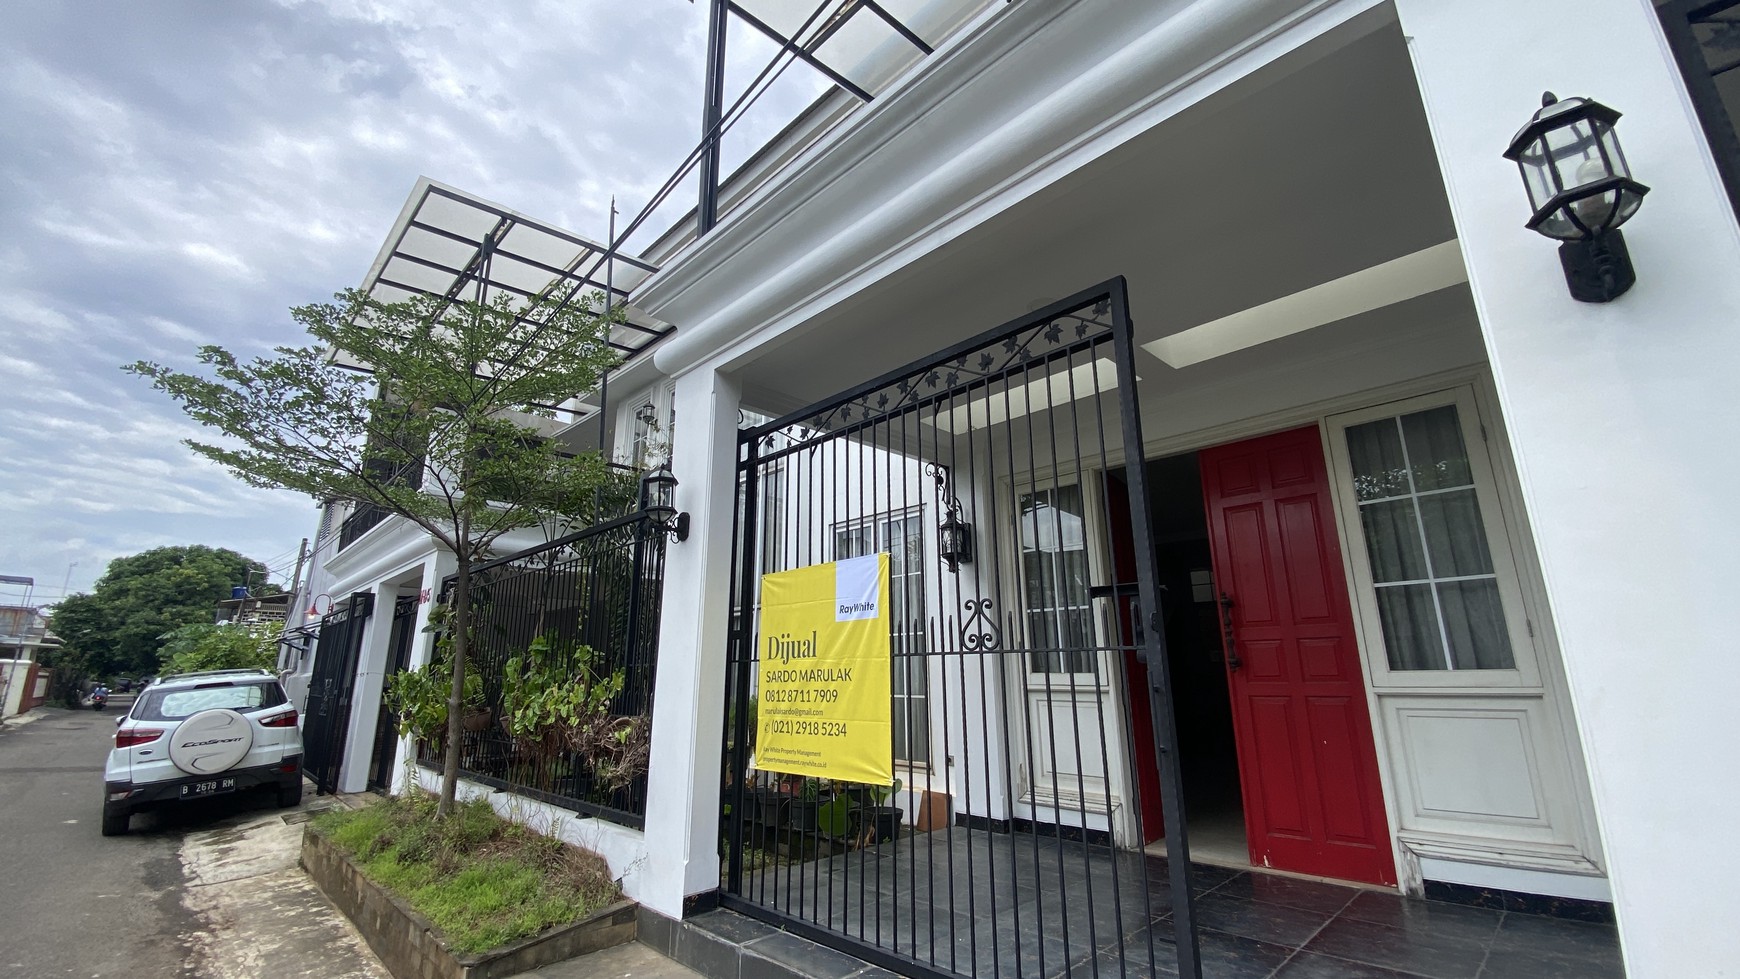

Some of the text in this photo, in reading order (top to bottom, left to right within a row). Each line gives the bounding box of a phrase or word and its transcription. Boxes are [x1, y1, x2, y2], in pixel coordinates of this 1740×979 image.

[839, 602, 875, 615] RayWhite
[767, 630, 817, 665] Dijual
[766, 667, 852, 684] SARDO MARULAK
[765, 689, 838, 703] 0812 8711 7909
[771, 719, 847, 737] (021) 2918 5234
[182, 785, 189, 794] B
[195, 781, 217, 793] 2678
[222, 778, 234, 788] RM
